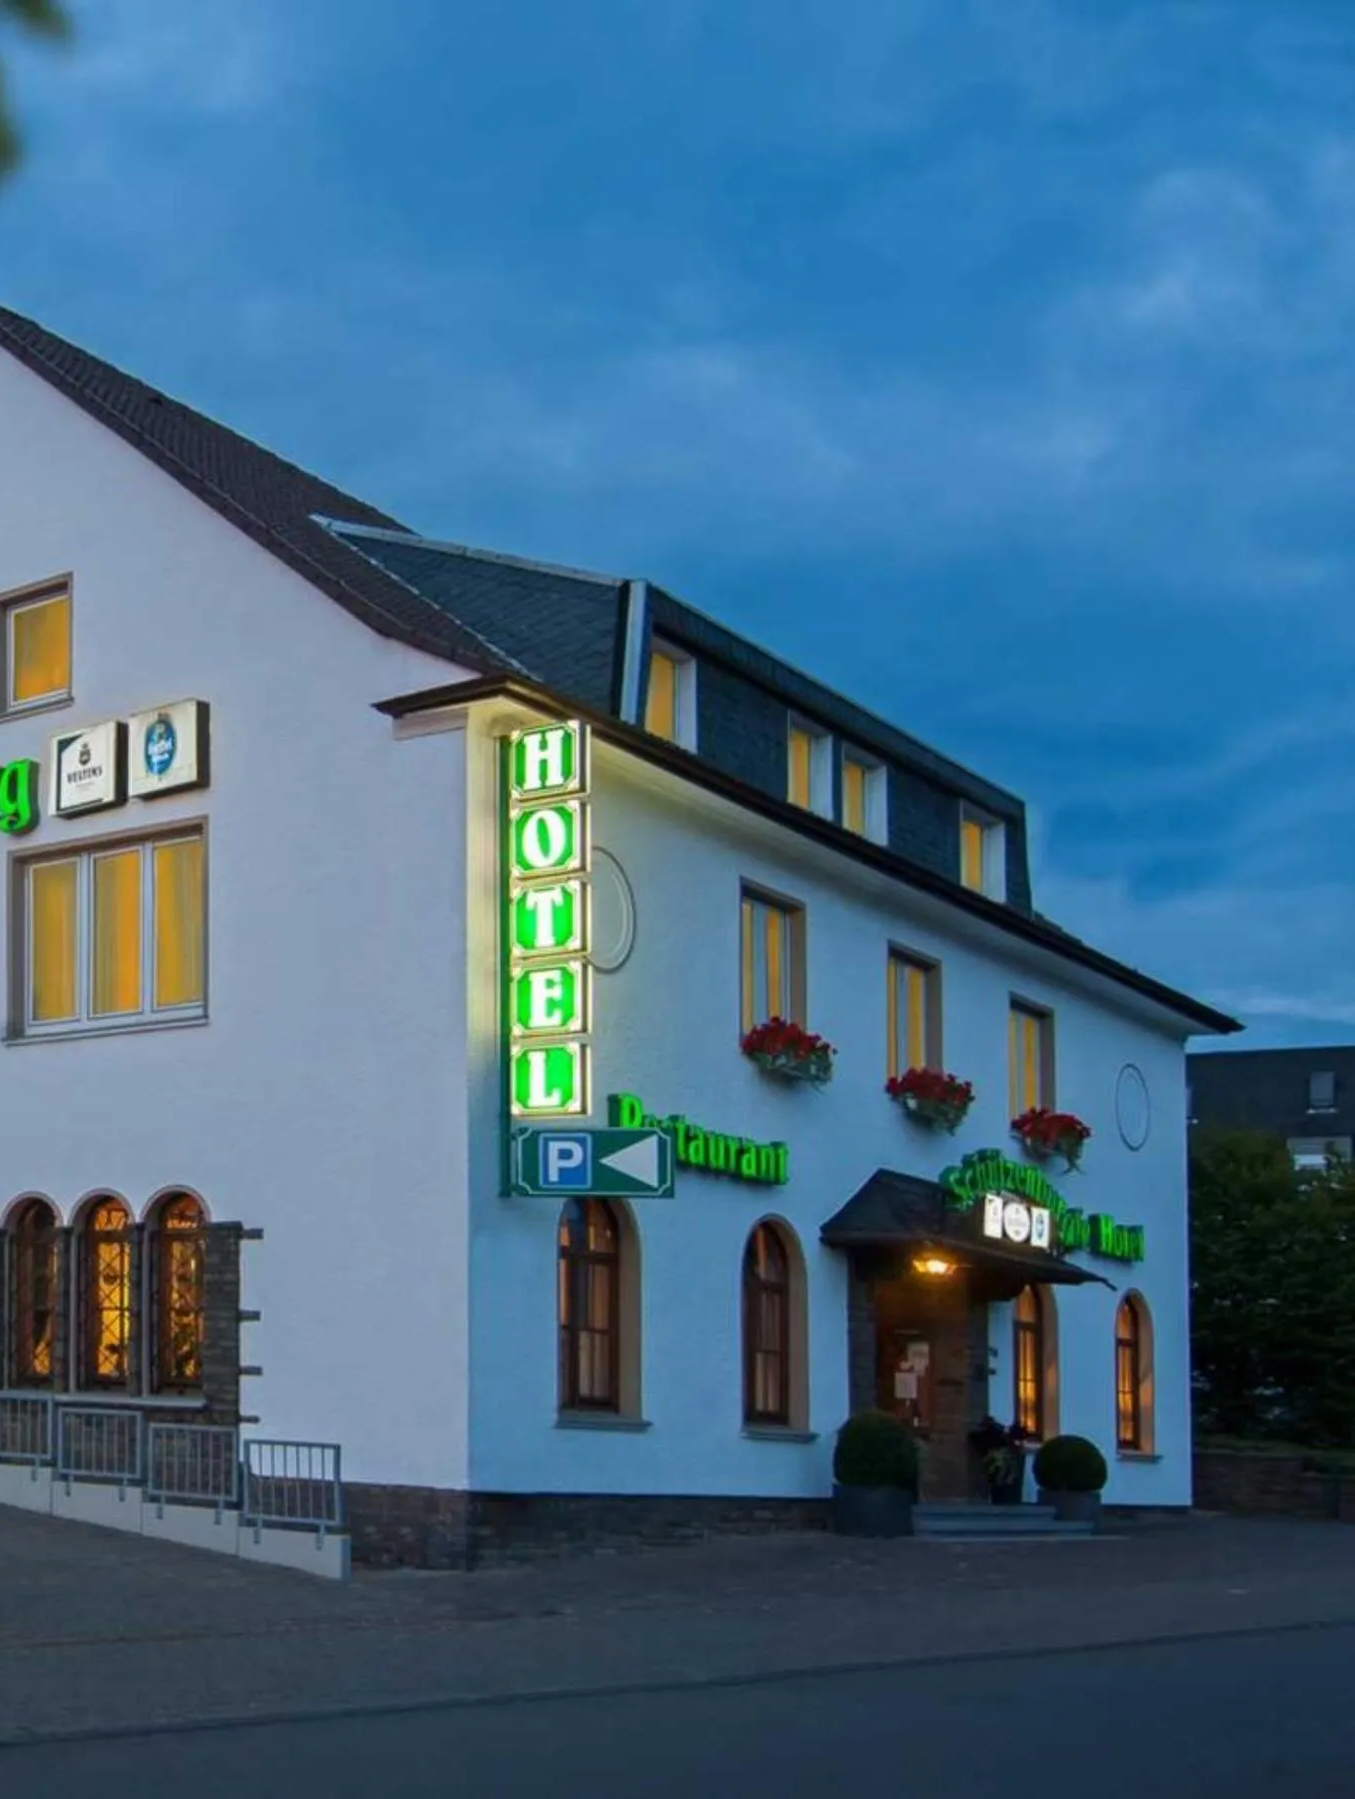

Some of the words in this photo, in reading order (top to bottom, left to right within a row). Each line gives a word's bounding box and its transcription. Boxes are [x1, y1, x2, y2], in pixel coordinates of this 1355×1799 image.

[522, 730, 567, 1108] HOTEL
[548, 1141, 584, 1182] P
[609, 1093, 789, 1184] Rtaurant
